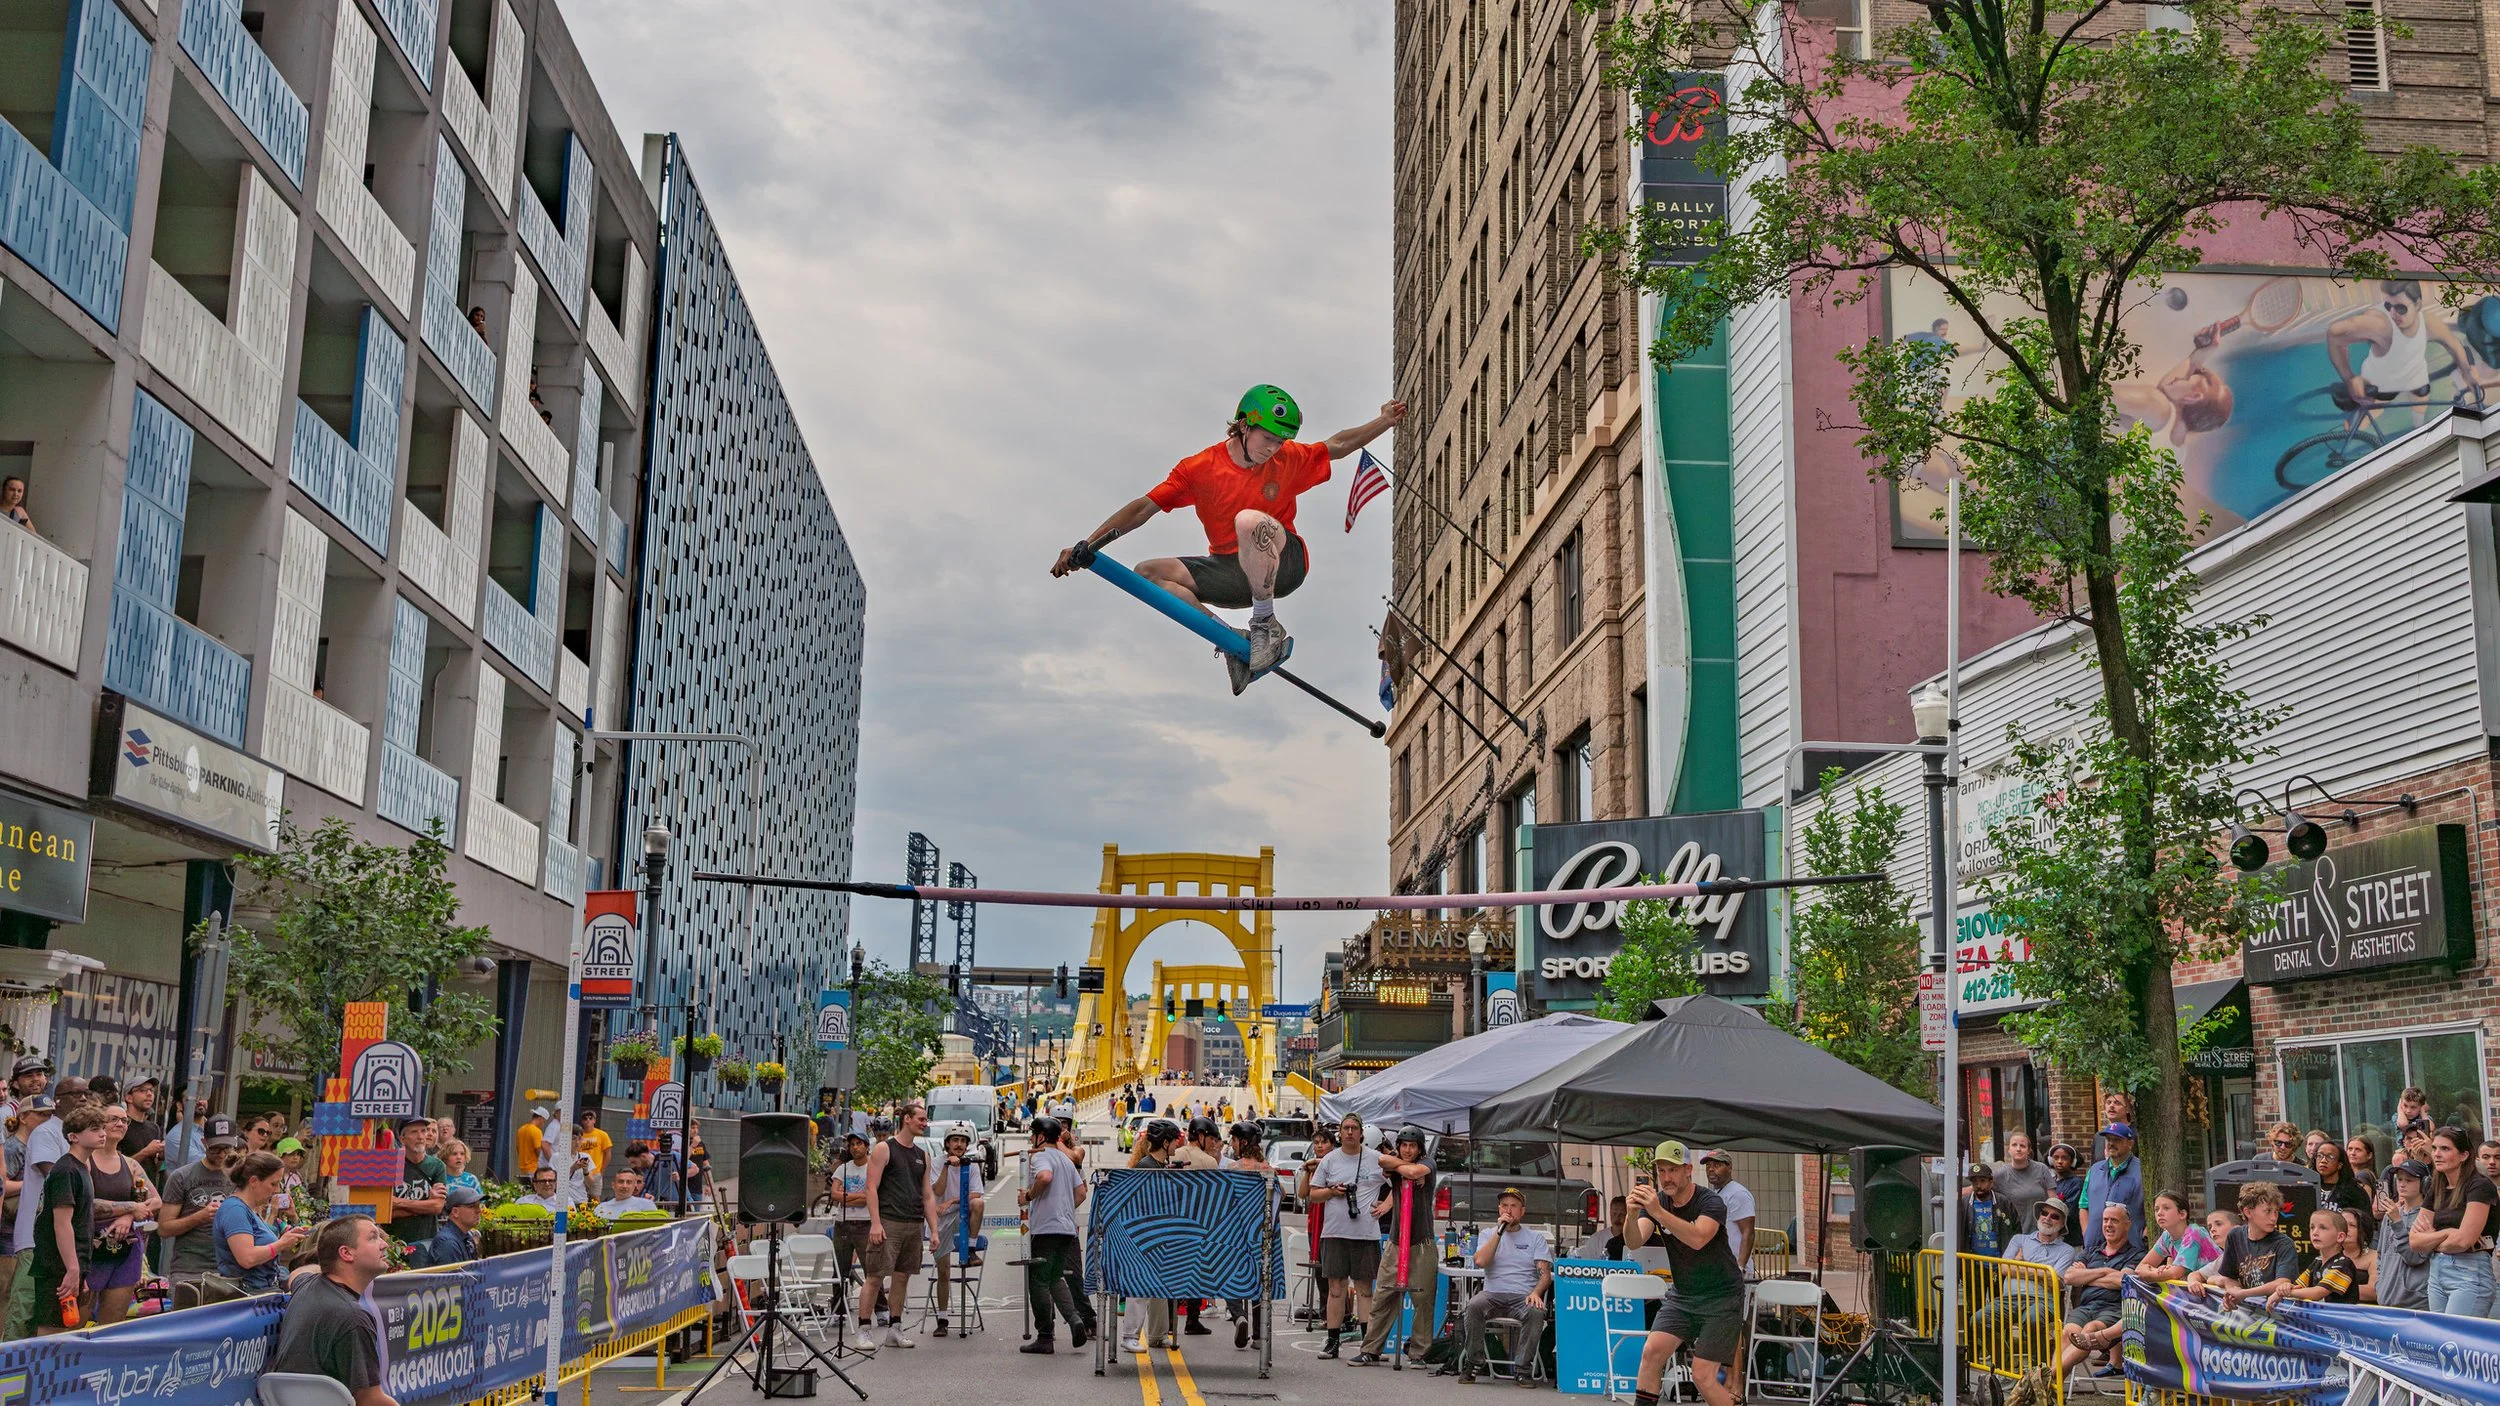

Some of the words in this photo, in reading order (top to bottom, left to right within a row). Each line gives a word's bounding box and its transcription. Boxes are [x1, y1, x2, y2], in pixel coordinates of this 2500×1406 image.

[1656, 202, 1715, 213] BALLY
[1659, 218, 1713, 230] PORT
[152, 746, 199, 780] Pittsburgh
[200, 767, 244, 799] PARKING
[2012, 800, 2036, 818] PIZZ
[0, 821, 75, 862] nean
[1965, 835, 1996, 857] ORD
[2010, 817, 2063, 842] OLINE
[2346, 870, 2432, 930] STREET
[1380, 927, 1515, 949] RENAISAN
[1957, 911, 2011, 944] GIOVA
[2274, 948, 2312, 972] DENTAL
[2350, 930, 2416, 961] AESTHETICS
[585, 967, 632, 976] STREET
[1541, 956, 1612, 979] SPOR
[1921, 975, 1932, 988] NO
[71, 971, 180, 1032] WELCOM
[1379, 986, 1429, 1004] BYHAM
[1273, 1010, 1303, 1018] Duquesne
[62, 1026, 178, 1084] PITTSBU
[2223, 1052, 2255, 1063] STREET
[354, 1103, 409, 1114] STREET
[2294, 1240, 2311, 1254] ST
[408, 1285, 462, 1349] 2025
[1566, 1295, 1634, 1313] JUDGES
[229, 1336, 267, 1378] XPOGO
[389, 1344, 476, 1396] POGOPALOOZA
[2202, 1347, 2308, 1384] POGOPALOOZA
[2463, 1350, 2500, 1384] XPOG
